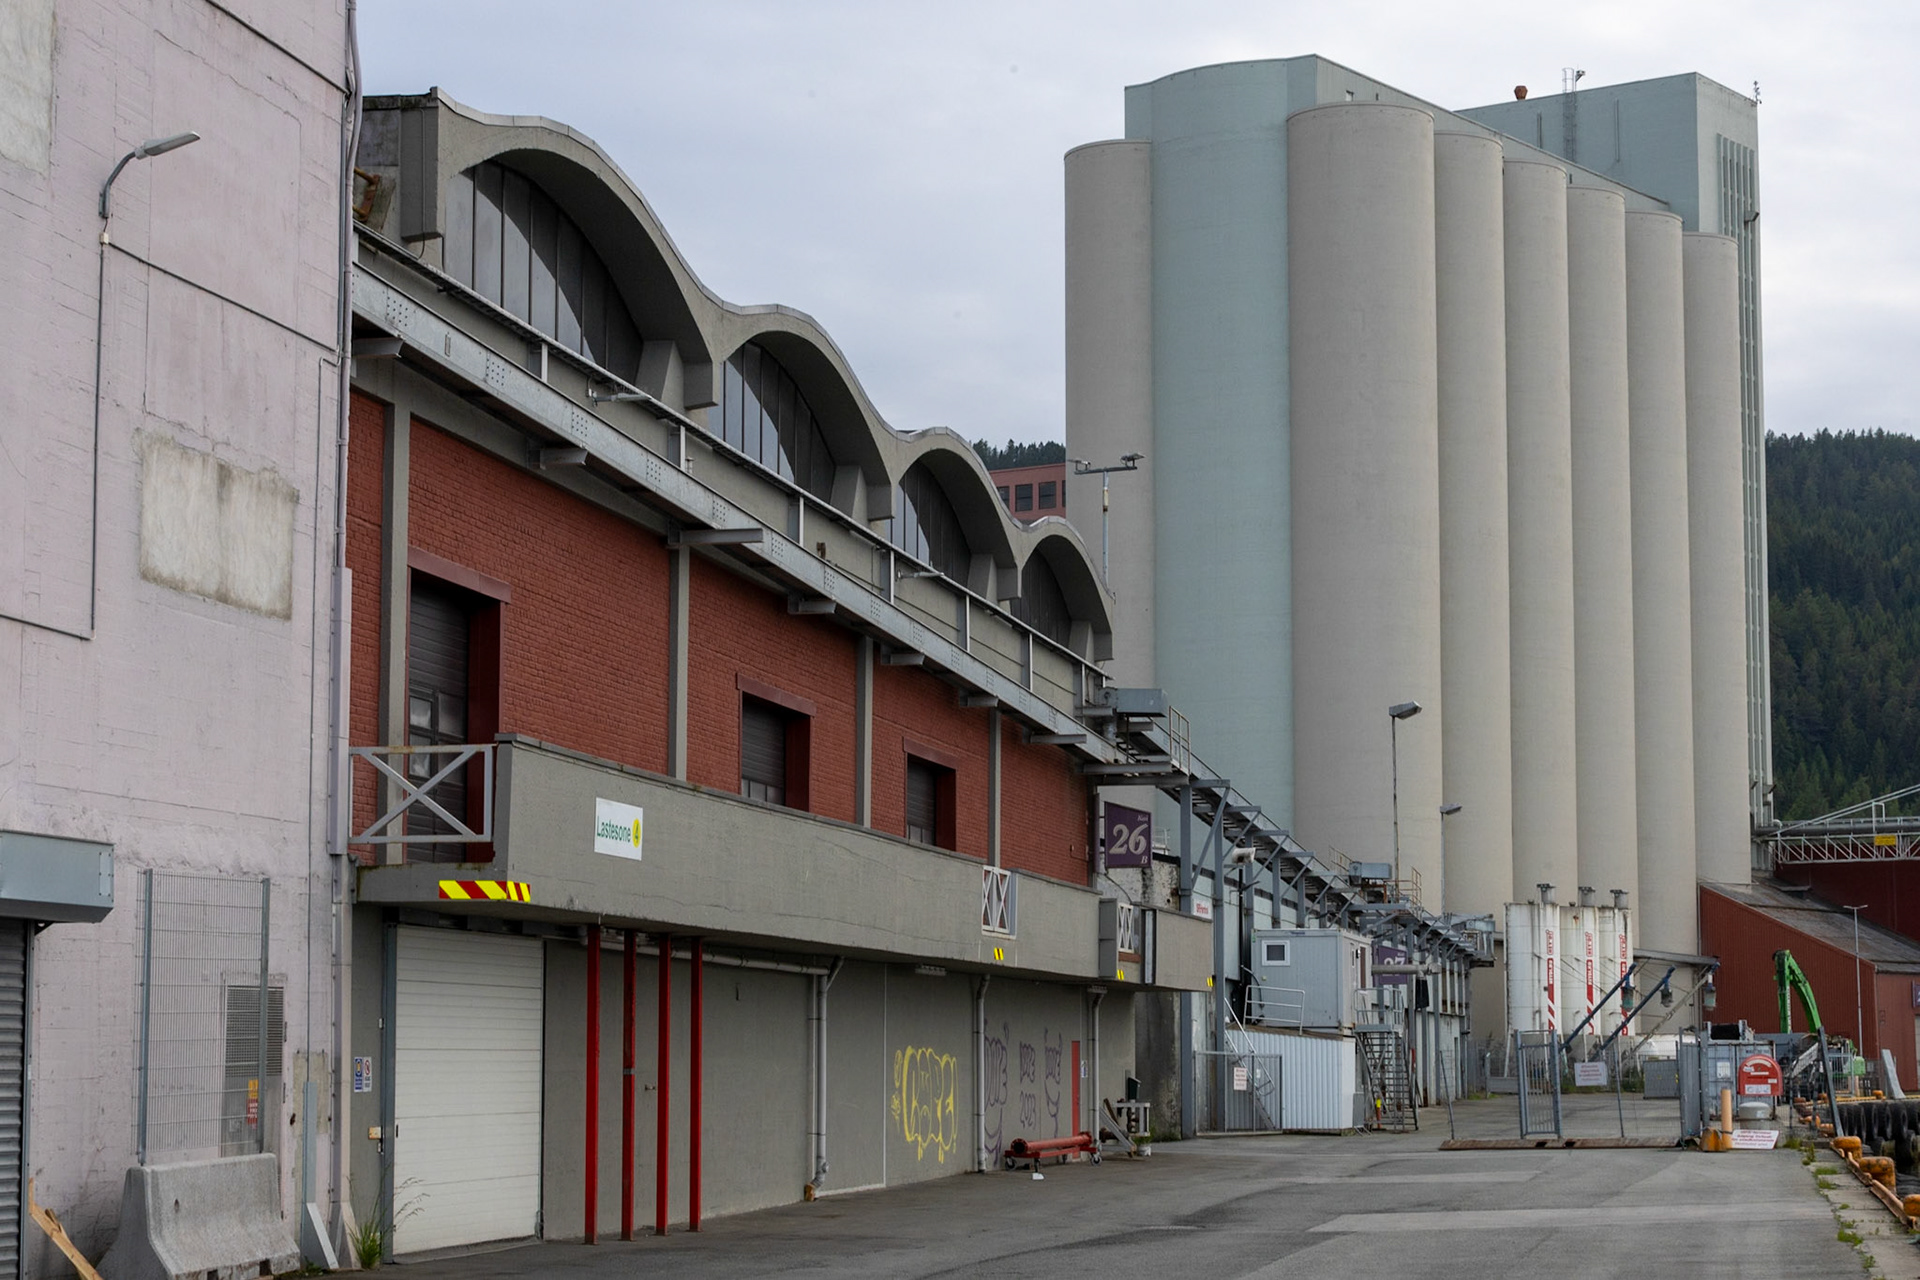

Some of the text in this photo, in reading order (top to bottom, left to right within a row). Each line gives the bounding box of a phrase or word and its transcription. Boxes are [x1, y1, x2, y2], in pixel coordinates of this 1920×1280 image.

[597, 815, 632, 843] Lastesone
[1108, 823, 1149, 855] 26
[1141, 855, 1148, 864] B
